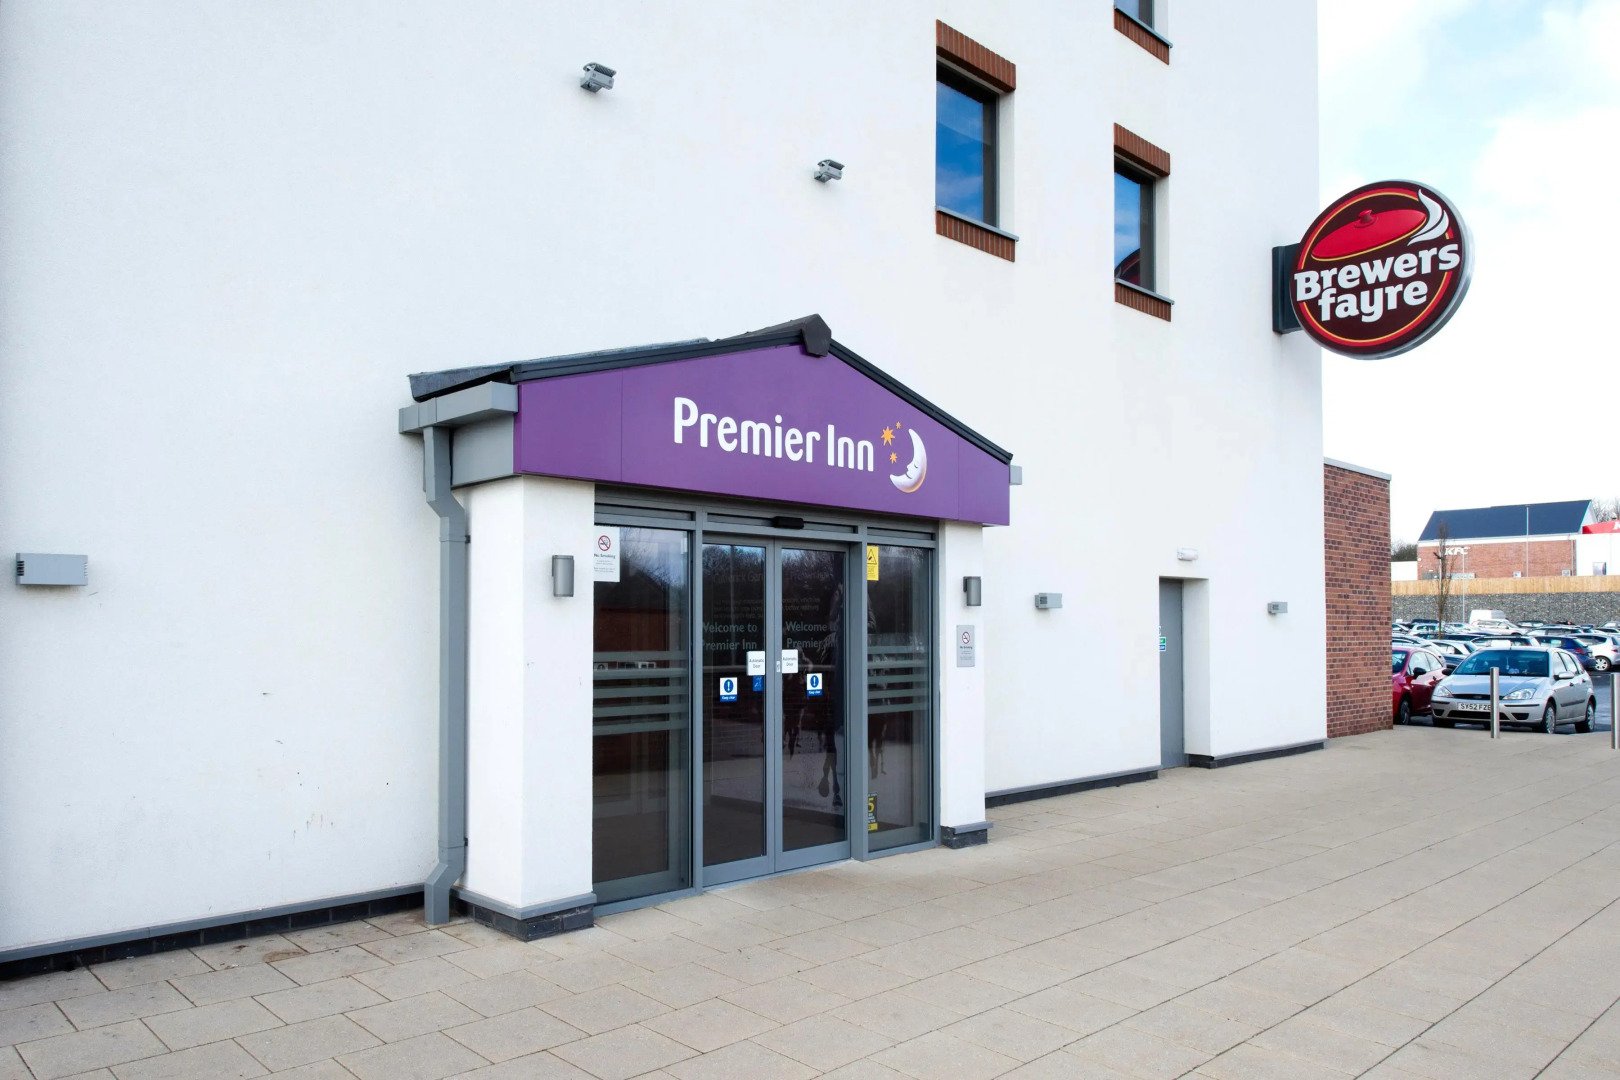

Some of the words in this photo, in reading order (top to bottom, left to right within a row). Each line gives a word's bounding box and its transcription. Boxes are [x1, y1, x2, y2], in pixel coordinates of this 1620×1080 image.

[1294, 243, 1461, 302] Brewers
[1318, 280, 1428, 323] fayre
[673, 396, 821, 463] Premier
[827, 424, 874, 472] Inn
[1444, 546, 1471, 556] KFC
[747, 622, 758, 633] to
[785, 620, 828, 632] Welcome
[742, 638, 758, 650] Inn
[786, 637, 822, 649] Premier
